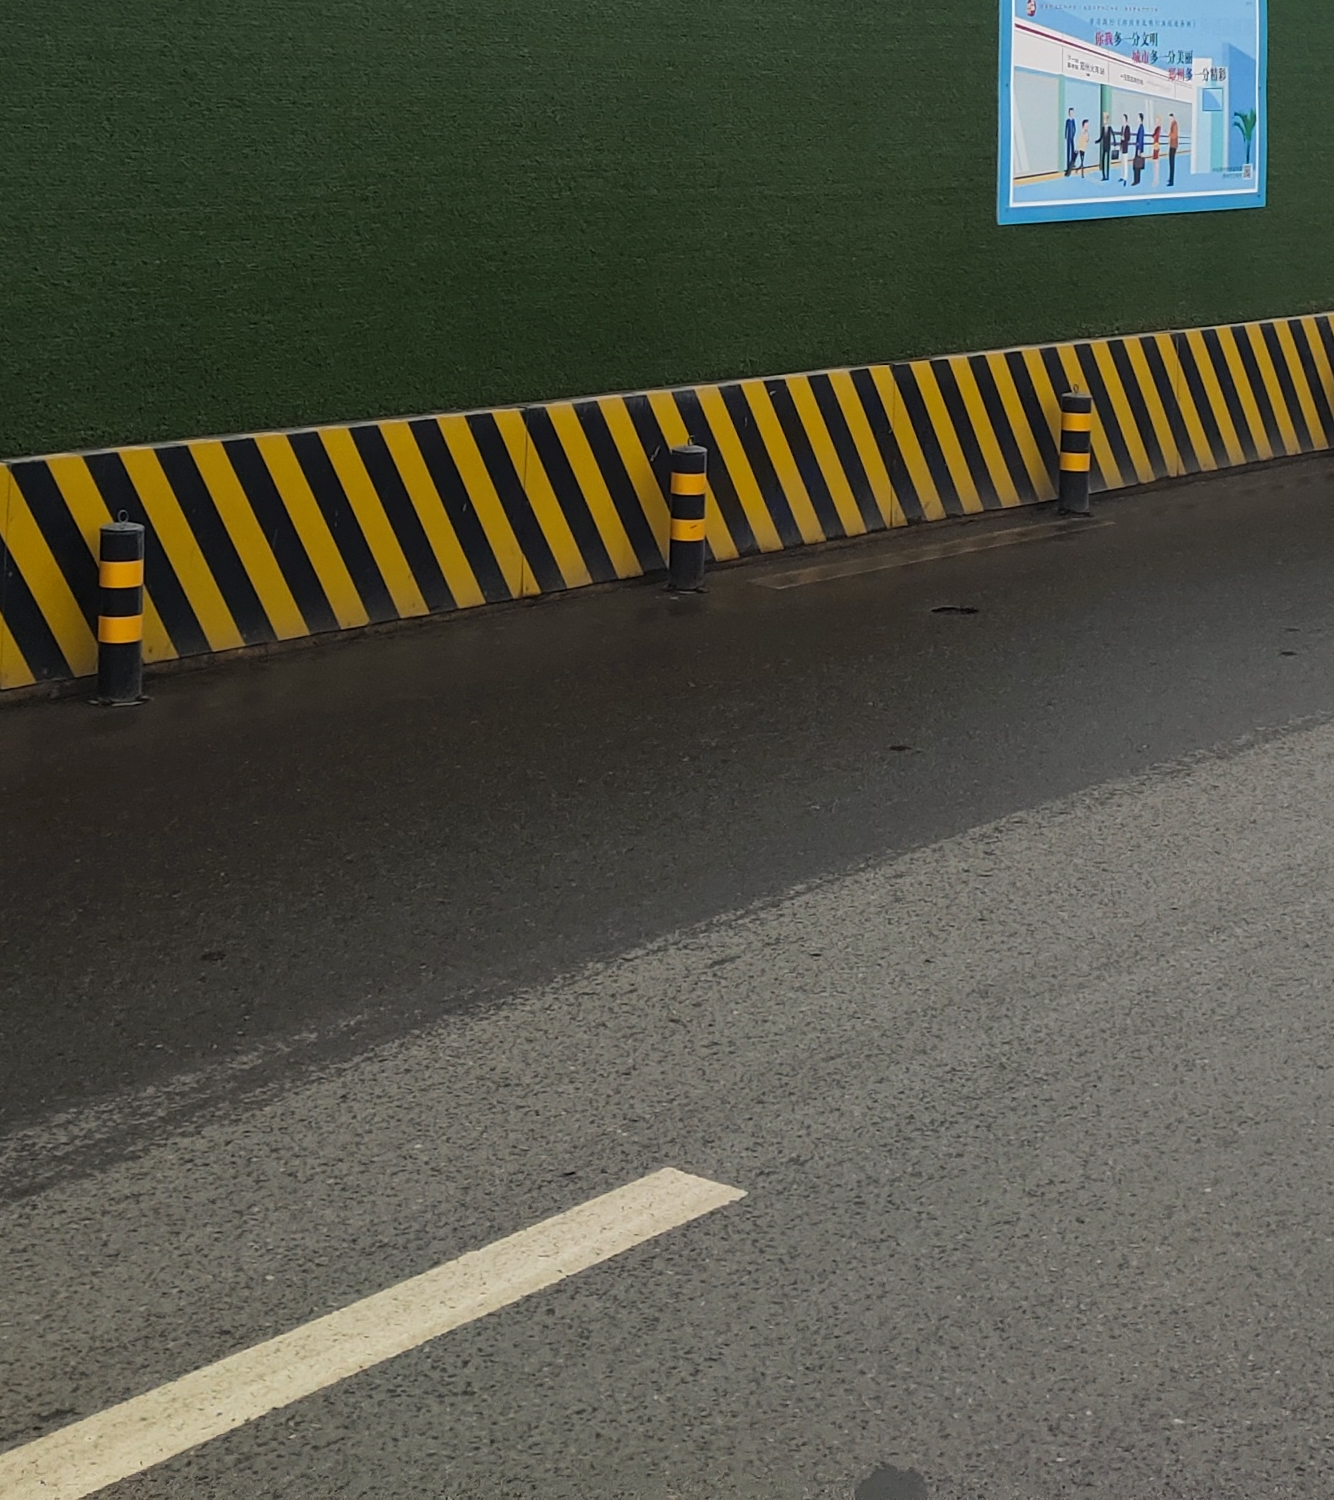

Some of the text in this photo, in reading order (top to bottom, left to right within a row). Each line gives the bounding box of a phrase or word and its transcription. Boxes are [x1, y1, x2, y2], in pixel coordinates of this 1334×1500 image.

[1095, 31, 1158, 46] 你我多一分文明
[1131, 50, 1193, 65] 城市多一分美丽
